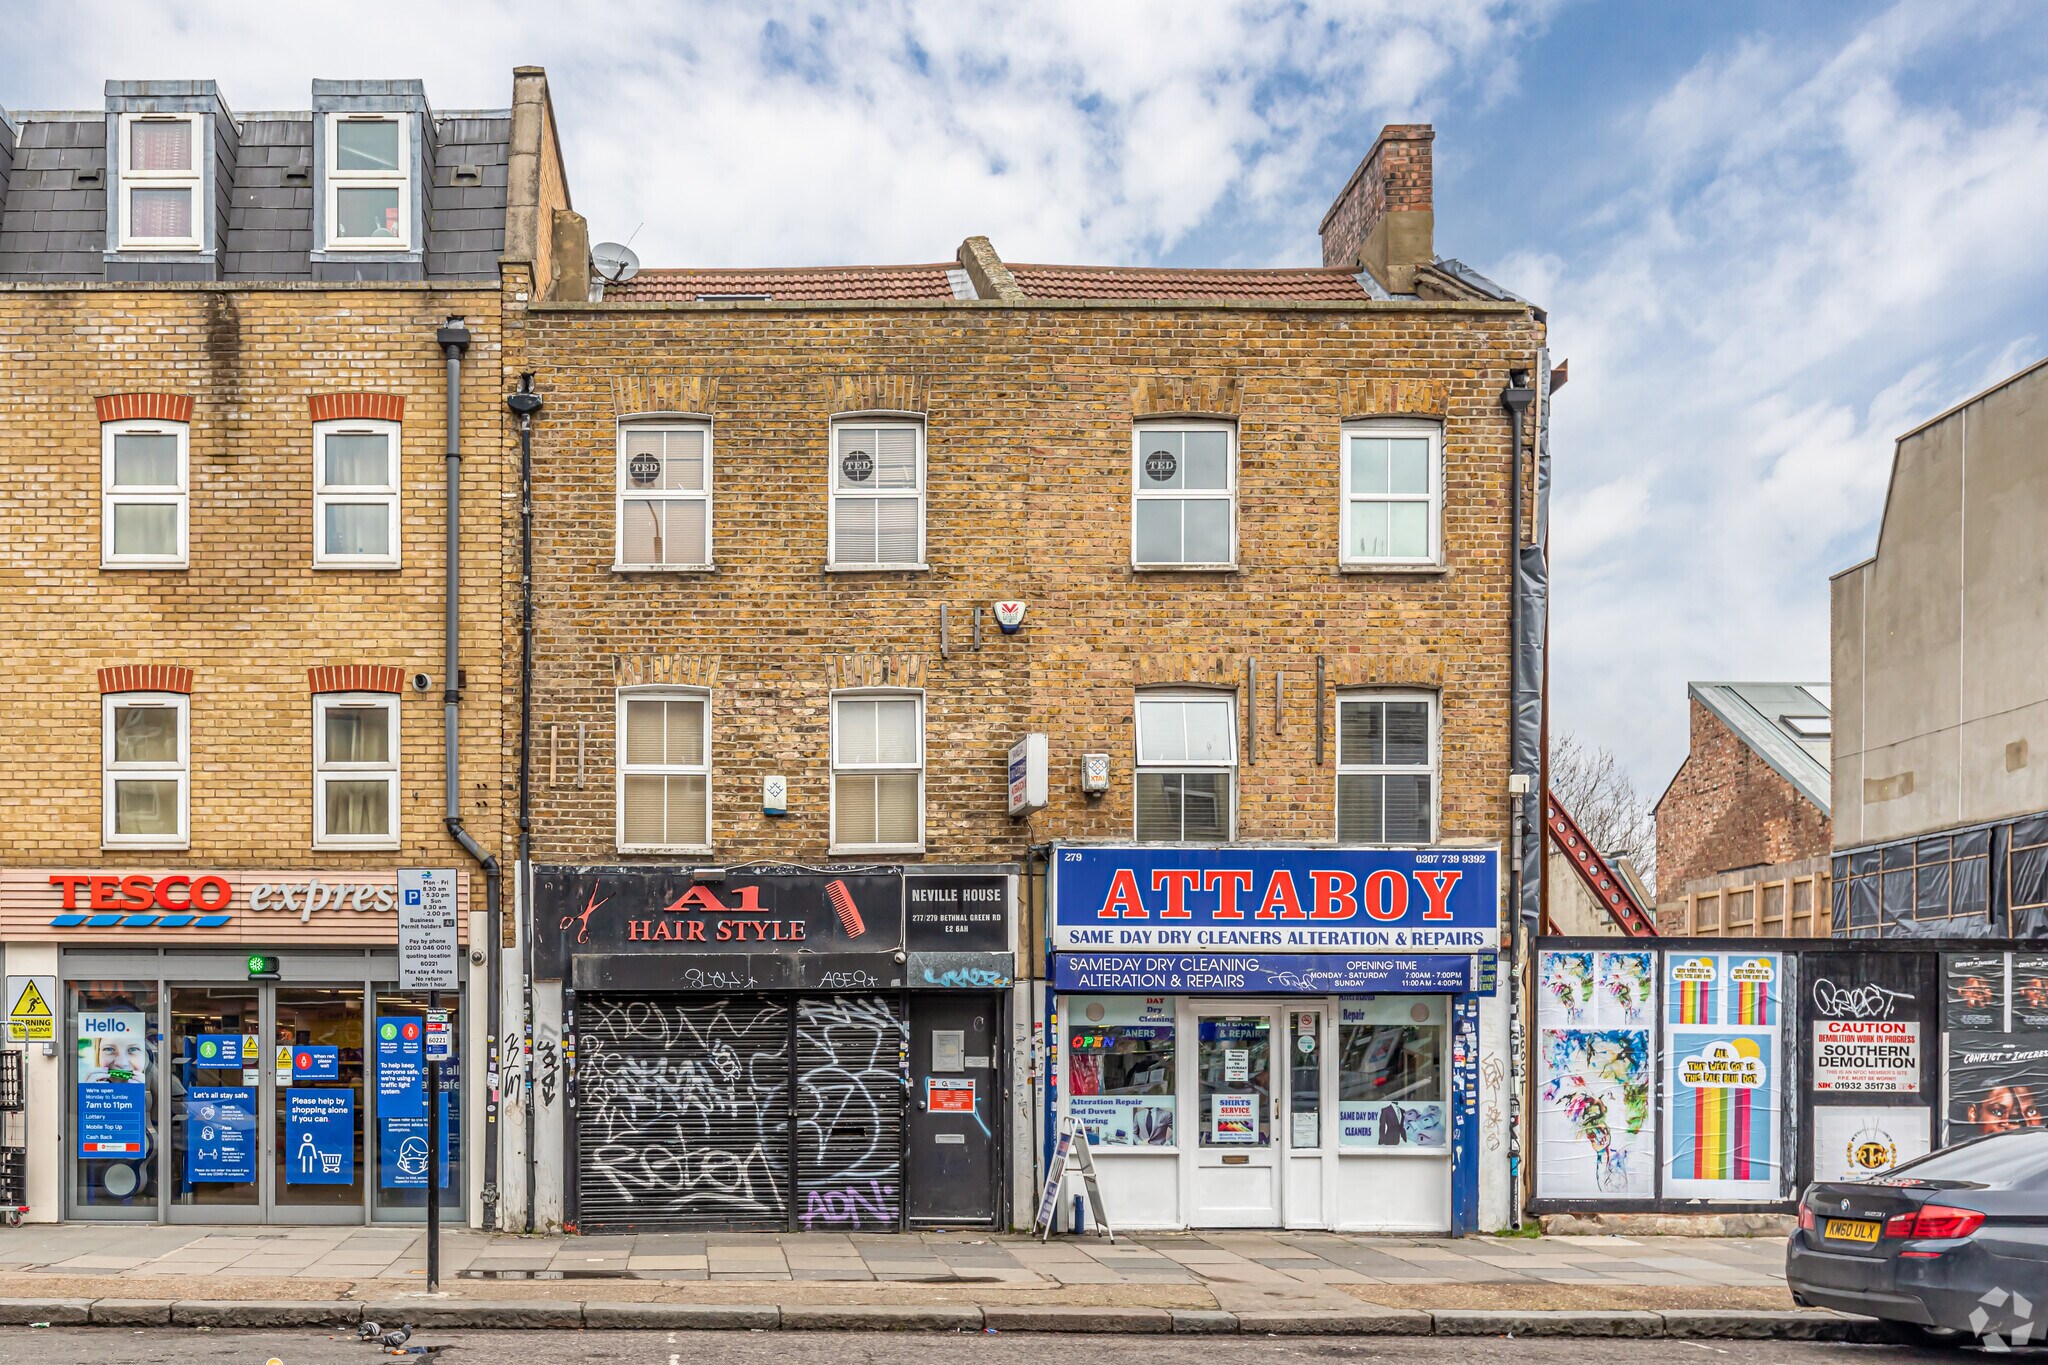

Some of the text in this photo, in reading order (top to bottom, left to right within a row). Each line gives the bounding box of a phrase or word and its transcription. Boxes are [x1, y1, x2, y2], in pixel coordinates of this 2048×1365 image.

[633, 464, 658, 472] TED
[846, 461, 870, 470] TED
[1150, 461, 1174, 470] TED
[1064, 853, 1082, 862] 279
[1416, 854, 1486, 864] 0207 739 9392
[50, 876, 398, 924] TESCO expres
[408, 892, 418, 904] P
[664, 885, 769, 912] A1
[912, 889, 1001, 902] NEVILLE HOUSE
[1098, 869, 1462, 922] ATTABOY
[628, 920, 806, 942] HAIR STYLE
[1070, 930, 1484, 945] SAME DAY DRY CLEANERS ALTERATION & REPAIRS
[1070, 958, 1259, 972] SAMEDAY DRY CLEANING
[1347, 961, 1417, 970] OPENING TIME
[1078, 974, 1244, 987] ALTERATION & REPAIRS
[1343, 1008, 1364, 1022] Repair
[86, 1018, 130, 1032] Hello.
[1828, 1022, 1906, 1034] CAUTION
[1072, 1035, 1115, 1048] OPEN
[1819, 1034, 1855, 1042] DEMOLITION
[1857, 1035, 1875, 1043] WORK
[1885, 1035, 1915, 1043] PROGRESS
[1714, 1048, 1729, 1058] ALL
[1824, 1045, 1910, 1056] SOUTHERN
[1819, 1057, 1915, 1068] DEMOLITION
[1964, 1052, 2003, 1064] CONFLICT
[1688, 1061, 1707, 1071] THAT
[1730, 1061, 1744, 1071] GOT
[1746, 1062, 1756, 1071] IS
[1684, 1073, 1702, 1083] THIS
[1704, 1073, 1720, 1082] PALE
[1723, 1074, 1740, 1083] BLUE
[113, 1102, 132, 1110] 11pm
[318, 1098, 334, 1106] help
[336, 1098, 345, 1106] by
[1340, 1112, 1378, 1121] SAME DAY DRY
[1345, 1127, 1371, 1136] CLEANERS
[1829, 1222, 1877, 1239] KM60 ULX
